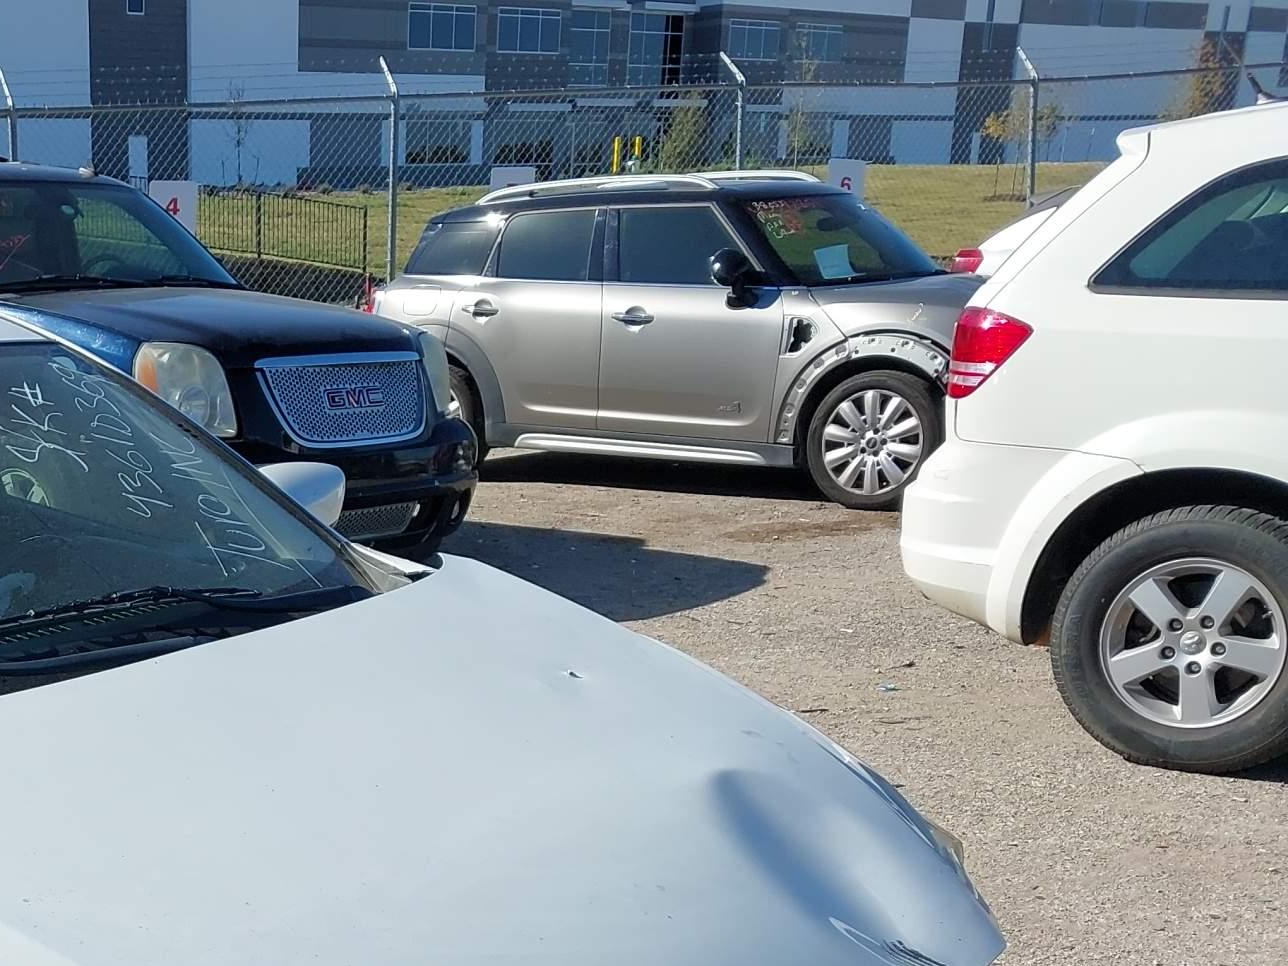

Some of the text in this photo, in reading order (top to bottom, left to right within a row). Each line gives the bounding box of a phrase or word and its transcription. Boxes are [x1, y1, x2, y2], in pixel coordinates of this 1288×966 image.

[840, 177, 852, 191] 6
[166, 197, 180, 215] 4
[324, 386, 386, 410] GMC
